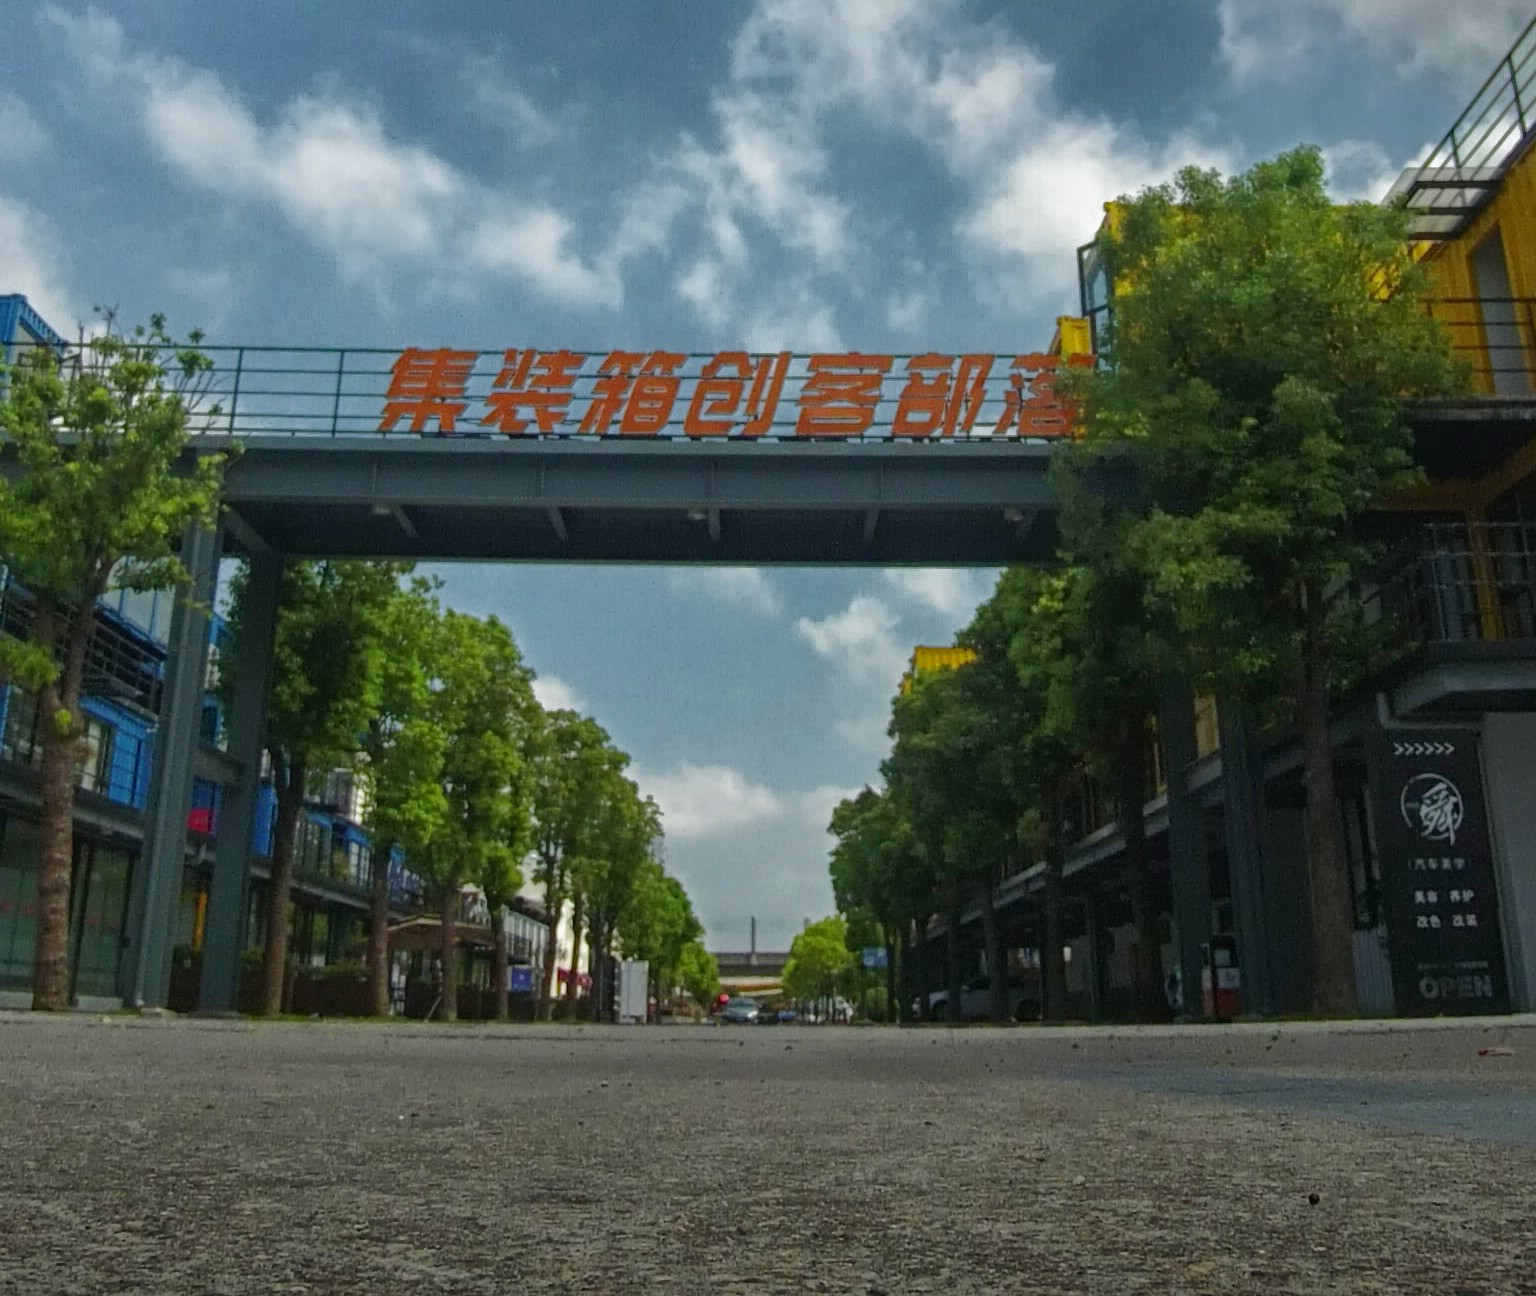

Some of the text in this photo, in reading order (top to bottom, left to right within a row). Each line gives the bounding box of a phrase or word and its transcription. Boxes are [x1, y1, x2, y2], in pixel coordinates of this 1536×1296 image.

[377, 348, 1095, 437] 集装箱创客部落
[1420, 976, 1492, 999] OPEN
